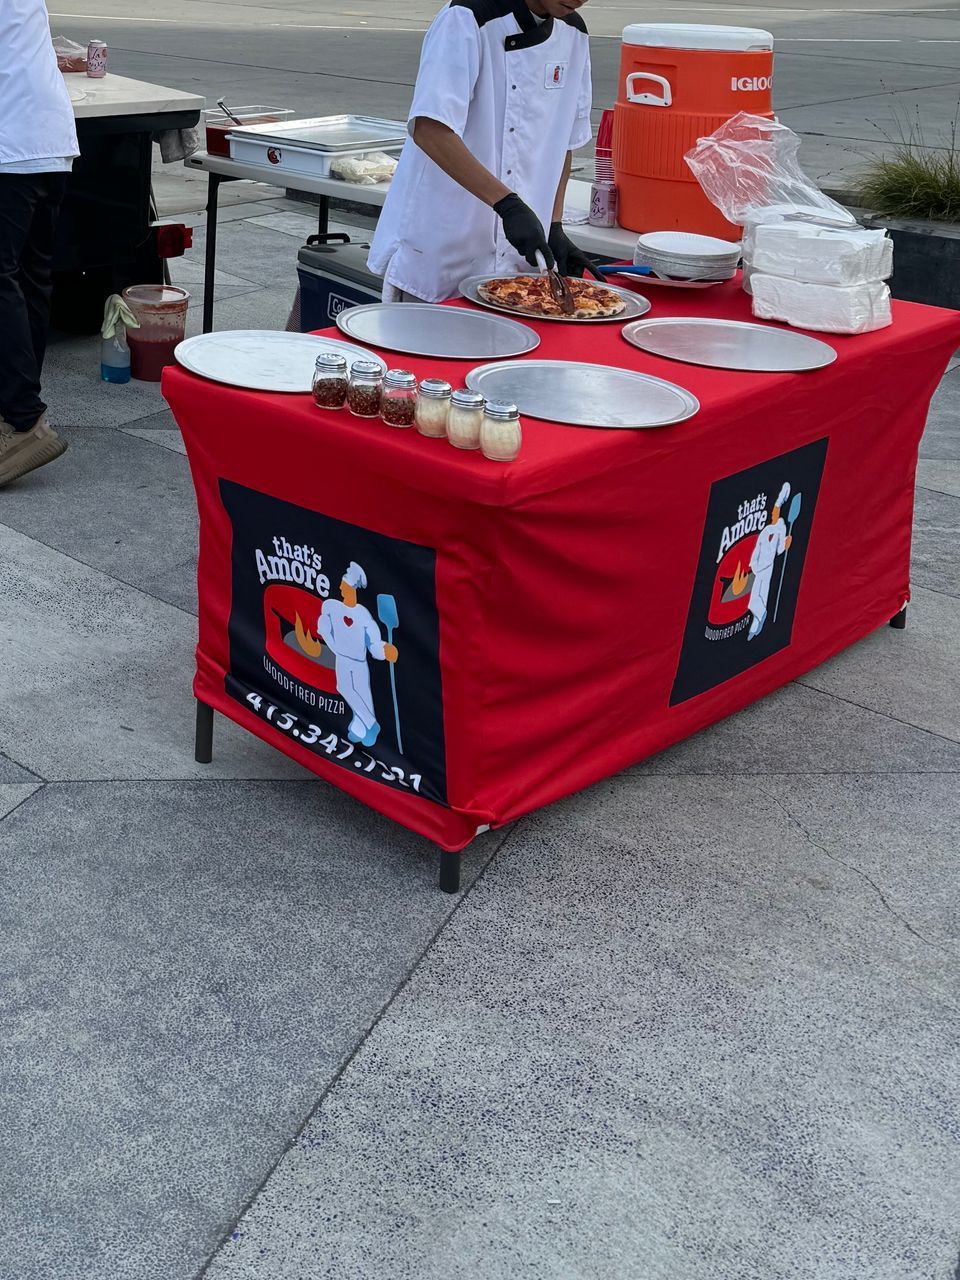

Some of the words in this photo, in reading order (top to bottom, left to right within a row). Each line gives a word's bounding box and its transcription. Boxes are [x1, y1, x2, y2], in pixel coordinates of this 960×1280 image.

[737, 492, 767, 520] that's
[272, 535, 322, 570] that's
[716, 510, 768, 564] Amore
[255, 548, 330, 598] Amore
[263, 655, 316, 707] WOODFIRED
[318, 695, 345, 715] PIZZA
